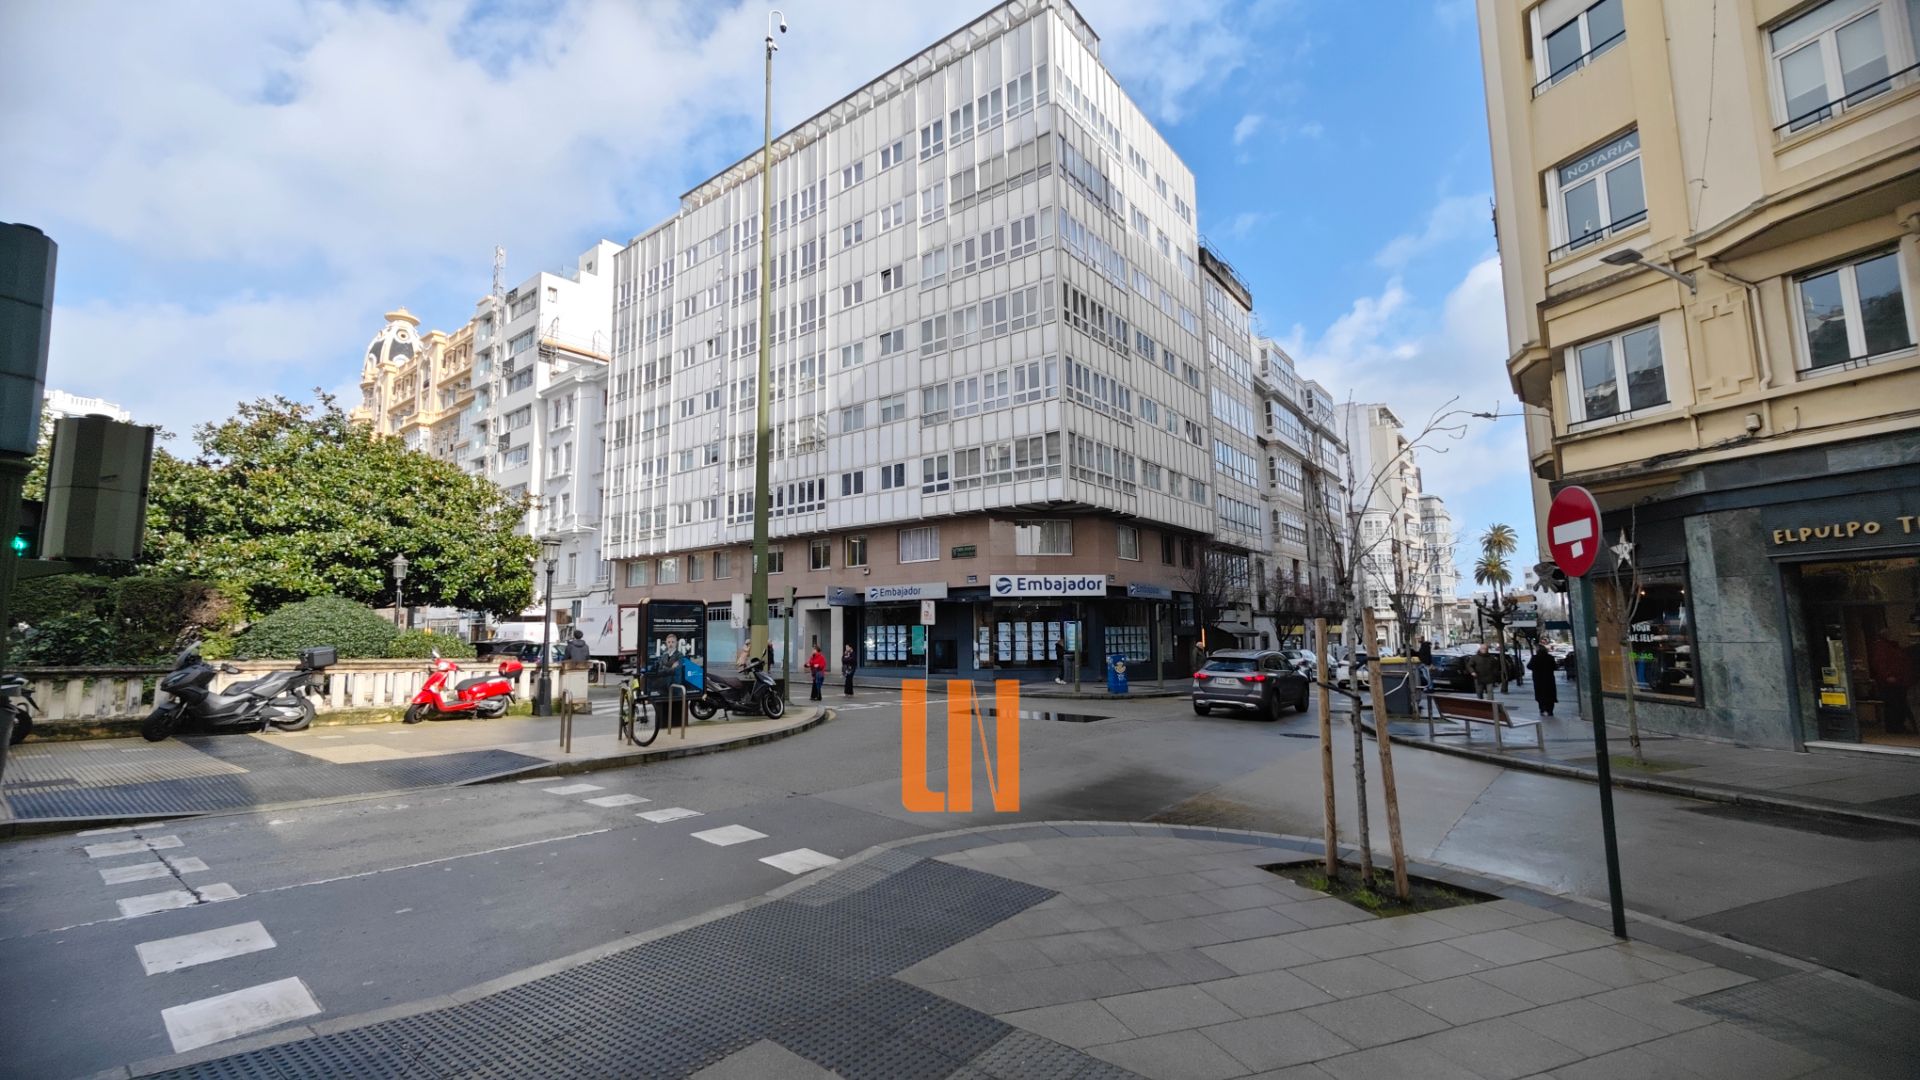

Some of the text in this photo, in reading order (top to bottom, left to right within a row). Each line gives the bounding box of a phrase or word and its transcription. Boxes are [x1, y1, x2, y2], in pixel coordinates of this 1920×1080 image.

[1896, 515, 1920, 534] T
[880, 587, 922, 598] Embajador
[1017, 577, 1102, 594] Embajador
[1632, 623, 1651, 632] YOUR
